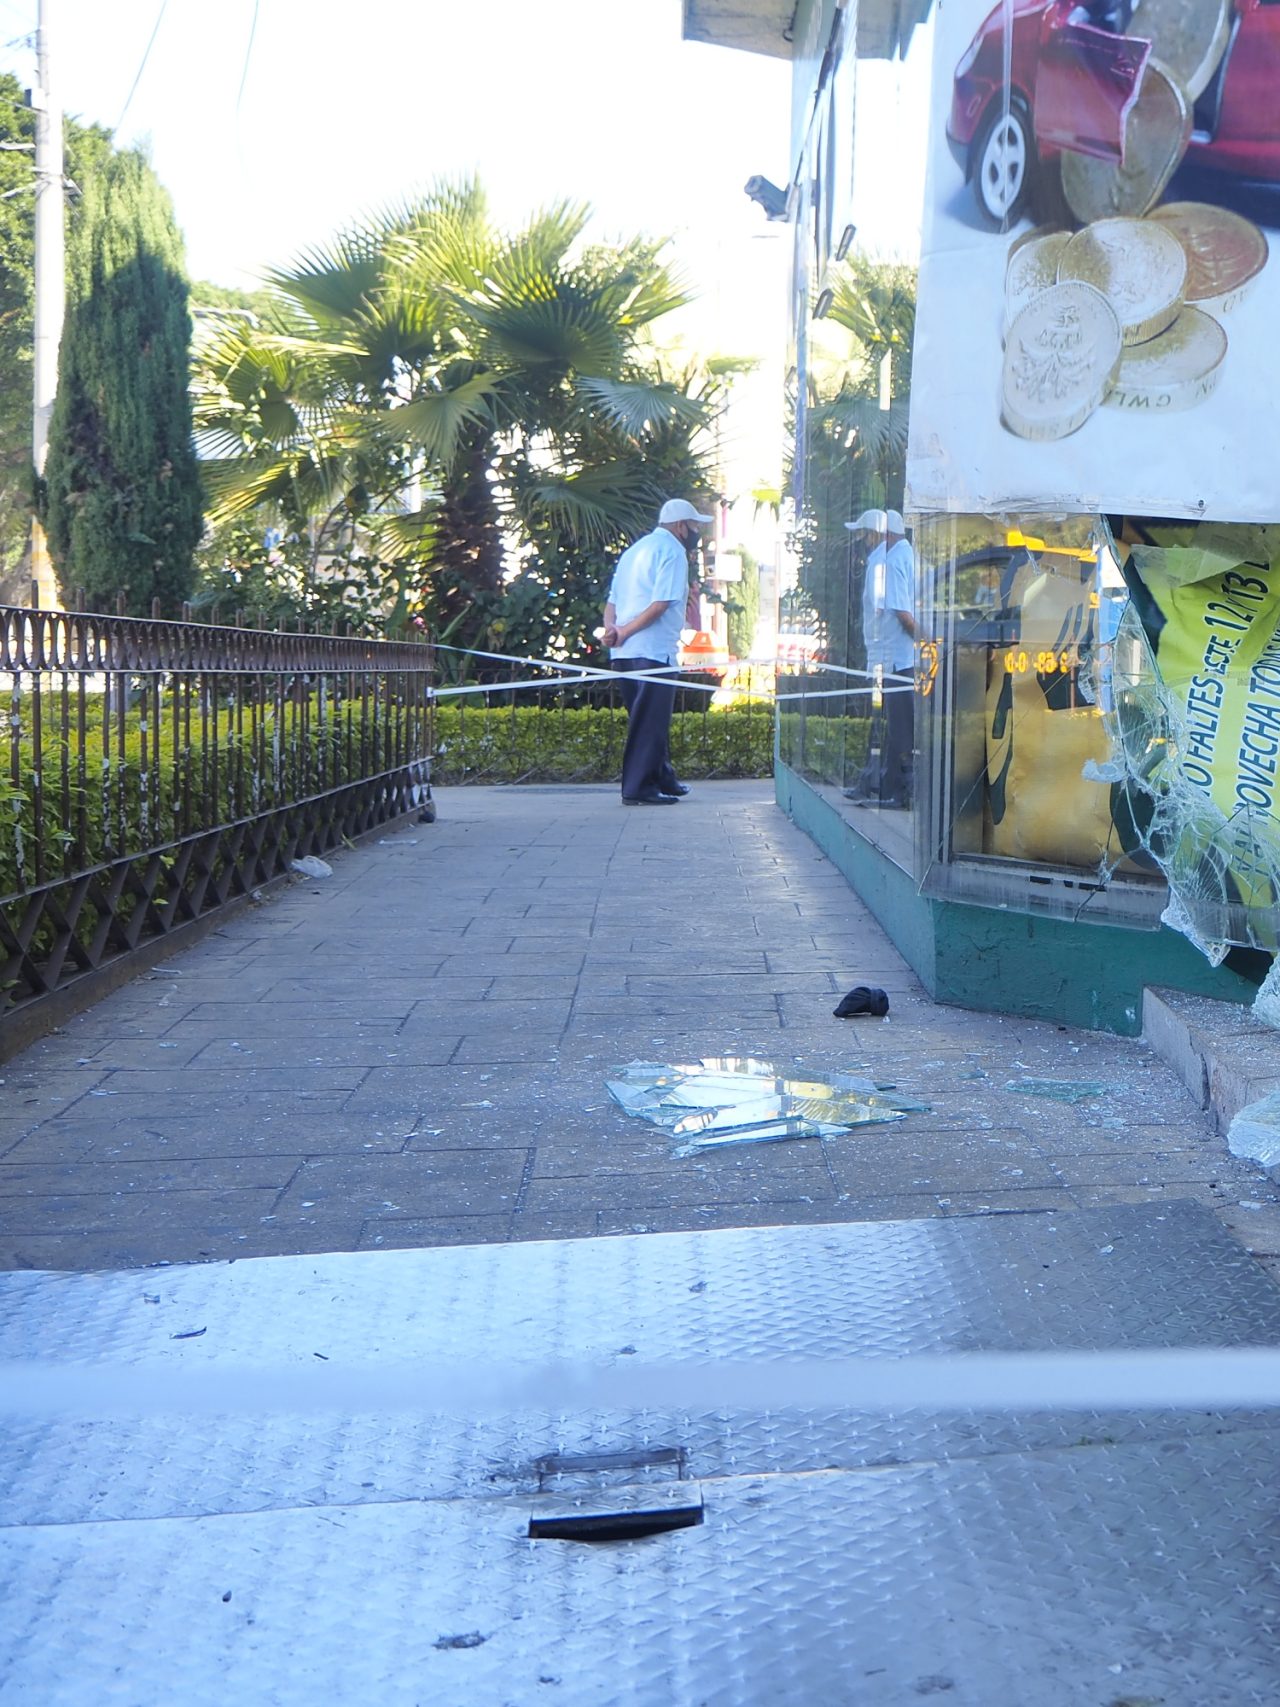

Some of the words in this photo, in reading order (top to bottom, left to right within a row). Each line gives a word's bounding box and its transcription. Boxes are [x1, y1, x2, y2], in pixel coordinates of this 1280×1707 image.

[1221, 571, 1269, 601] 13
[1204, 602, 1255, 631] 12
[1186, 676, 1225, 763] FALTES
